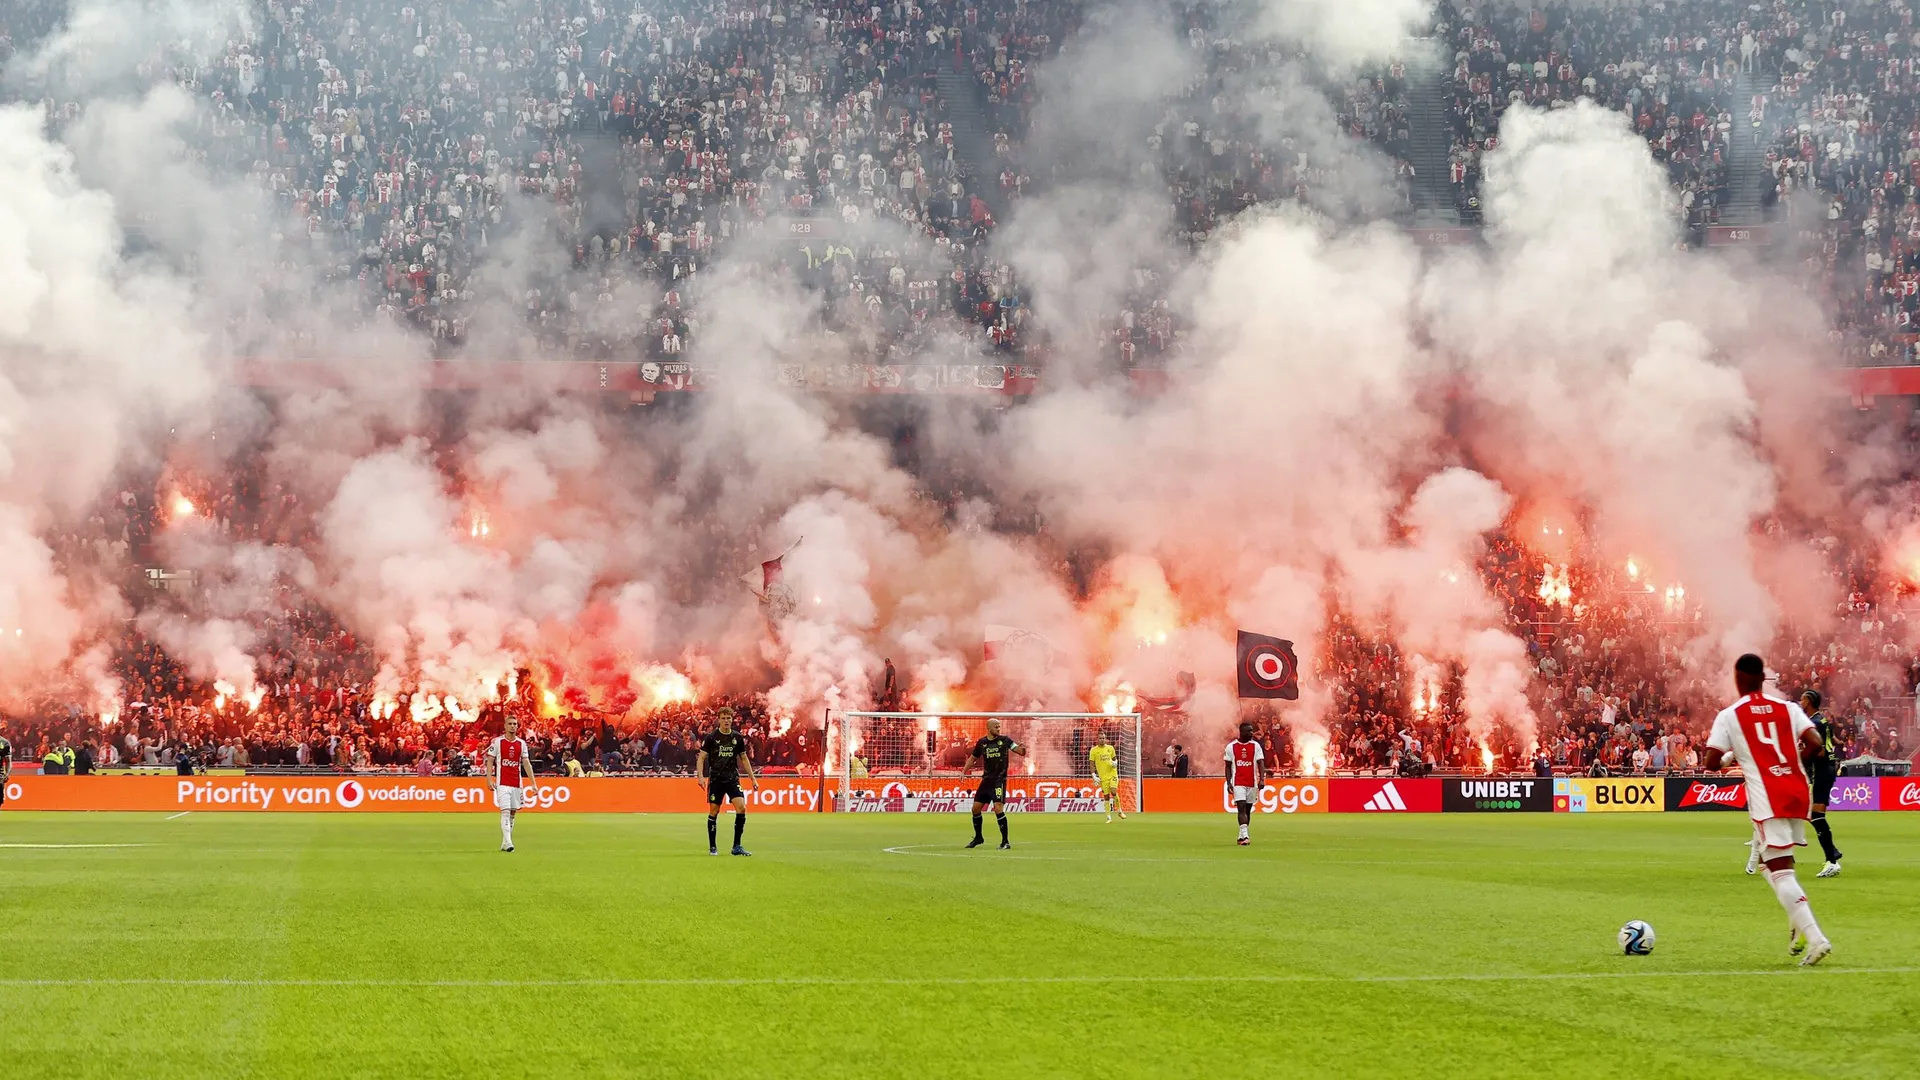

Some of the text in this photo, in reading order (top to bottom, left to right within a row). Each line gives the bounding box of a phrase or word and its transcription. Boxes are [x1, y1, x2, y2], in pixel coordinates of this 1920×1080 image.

[790, 223, 811, 233] 428
[1730, 230, 1750, 240] 430
[1754, 721, 1788, 764] 4
[178, 780, 275, 809] Priority
[282, 786, 330, 804] van
[367, 784, 447, 801] vodafone
[452, 786, 485, 804] en
[1223, 781, 1319, 813] ggo
[1460, 781, 1534, 798] UNIBET
[1595, 785, 1656, 805] BLOX
[1692, 783, 1741, 803] Bud
[847, 799, 888, 813] Flink
[916, 799, 959, 813] Flink
[1056, 799, 1099, 812] Flink
